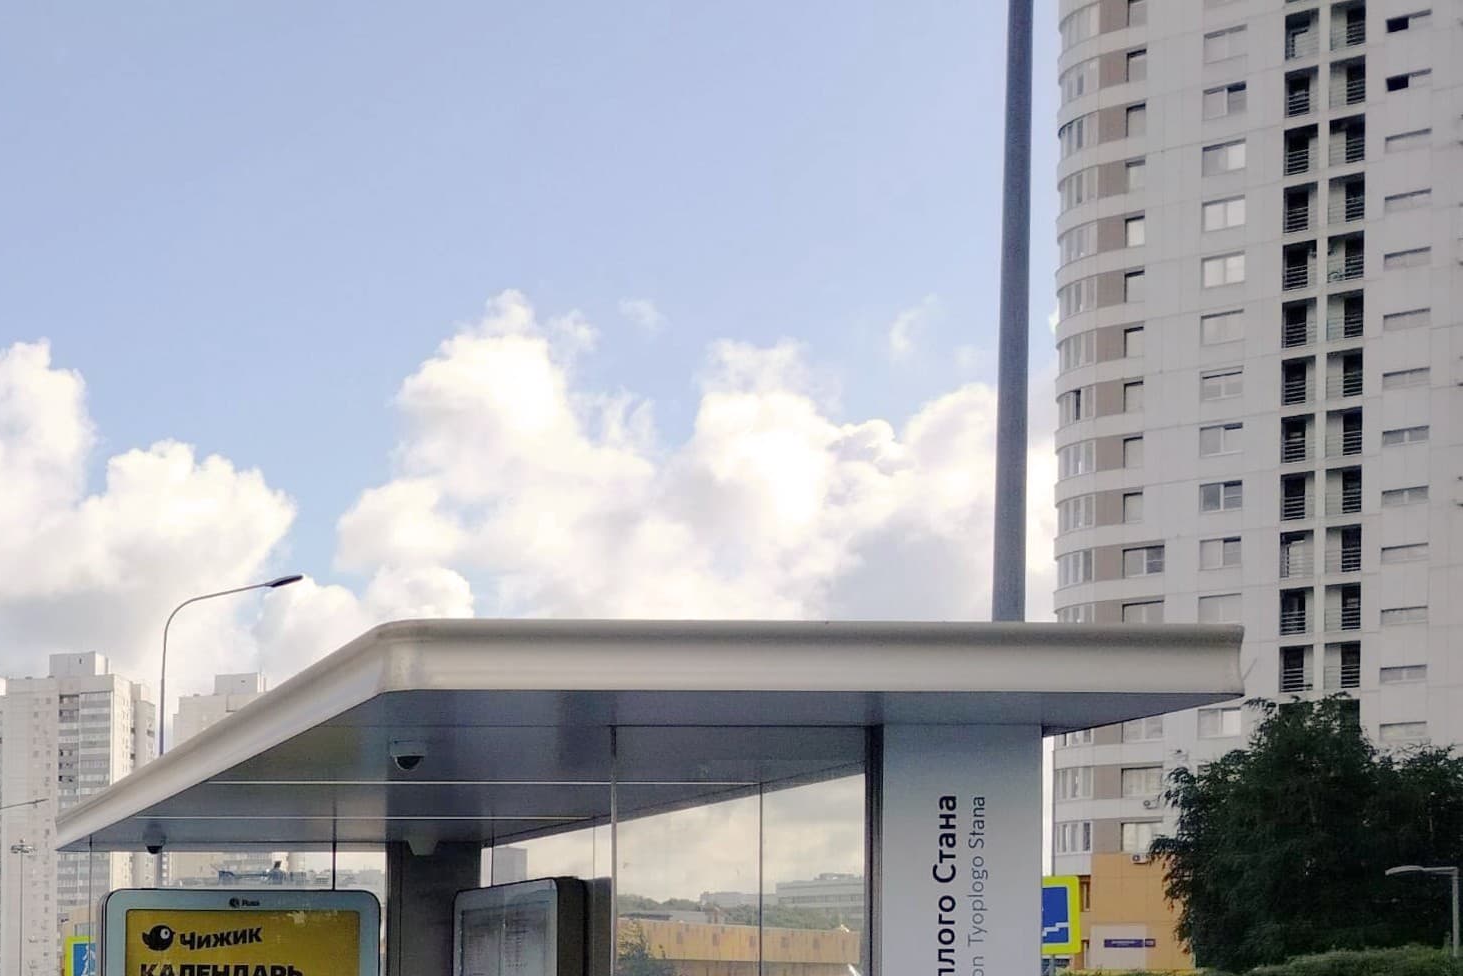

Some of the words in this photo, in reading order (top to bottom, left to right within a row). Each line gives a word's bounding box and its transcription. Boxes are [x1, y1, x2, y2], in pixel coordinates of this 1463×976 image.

[932, 794, 958, 883] Стана
[968, 796, 986, 849] Stana
[967, 855, 989, 947] Tyoplogo
